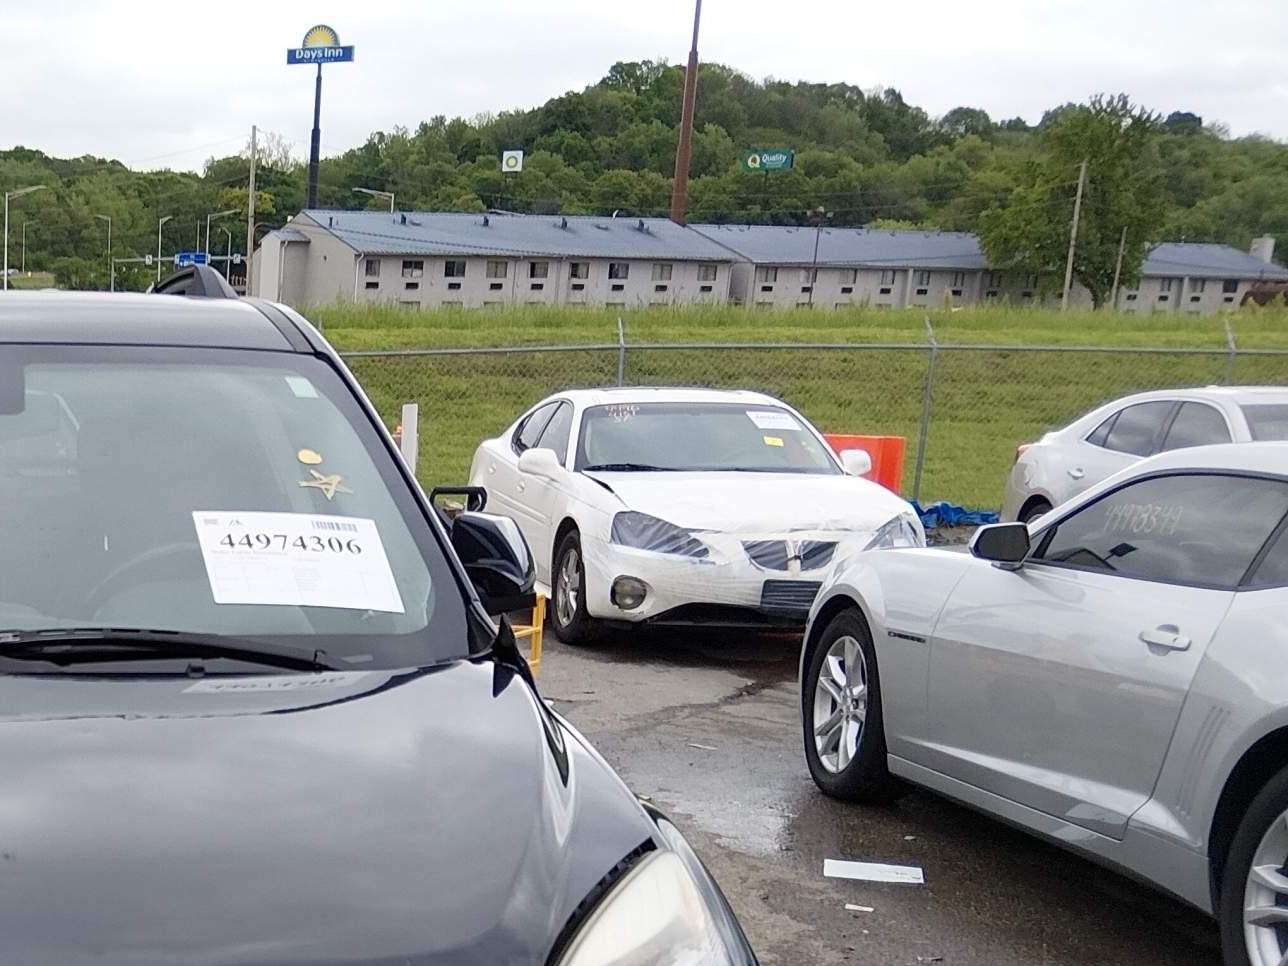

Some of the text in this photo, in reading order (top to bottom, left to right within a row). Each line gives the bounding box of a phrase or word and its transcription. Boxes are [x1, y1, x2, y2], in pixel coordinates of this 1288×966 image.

[295, 47, 344, 60] Days Inn
[761, 153, 788, 164] Quality
[220, 533, 363, 556] 44974306
